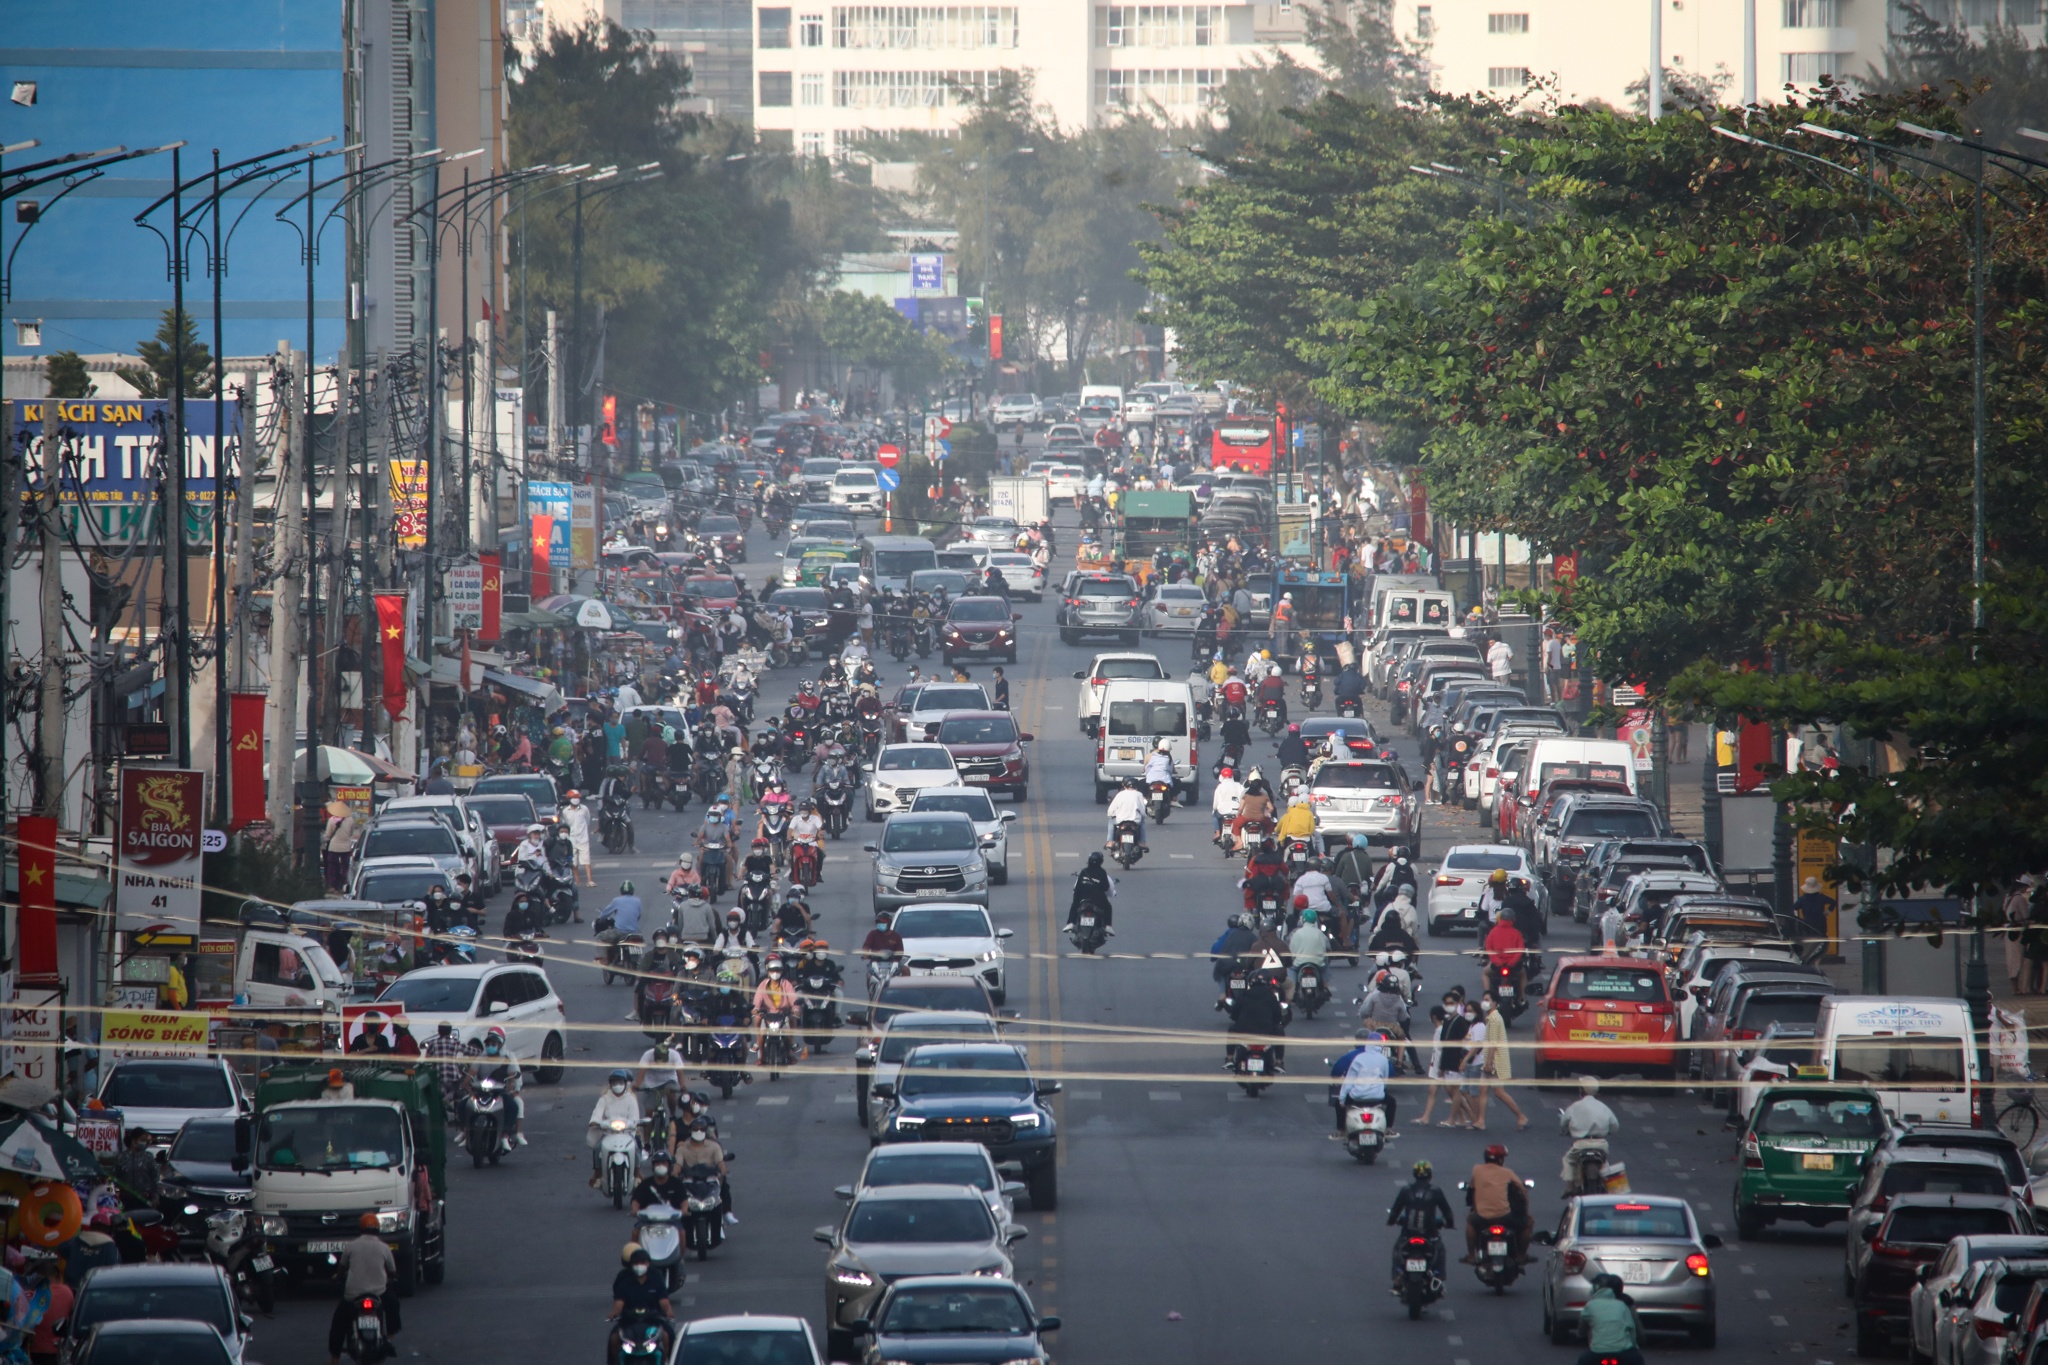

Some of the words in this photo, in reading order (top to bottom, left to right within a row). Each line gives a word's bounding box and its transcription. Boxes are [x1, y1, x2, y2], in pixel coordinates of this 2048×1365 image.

[24, 401, 96, 422] KÁCH
[101, 404, 143, 427] SẠN
[110, 488, 124, 501] TÀU
[553, 486, 569, 498] SẠN
[151, 823, 171, 832] BIA
[128, 831, 193, 848] SAIGON
[151, 895, 167, 908] 41
[1889, 1008, 1909, 1016] VIP
[107, 1025, 155, 1041] SÓNG
[161, 1025, 203, 1042] BIỂN
[1590, 1031, 1618, 1040] MPE
